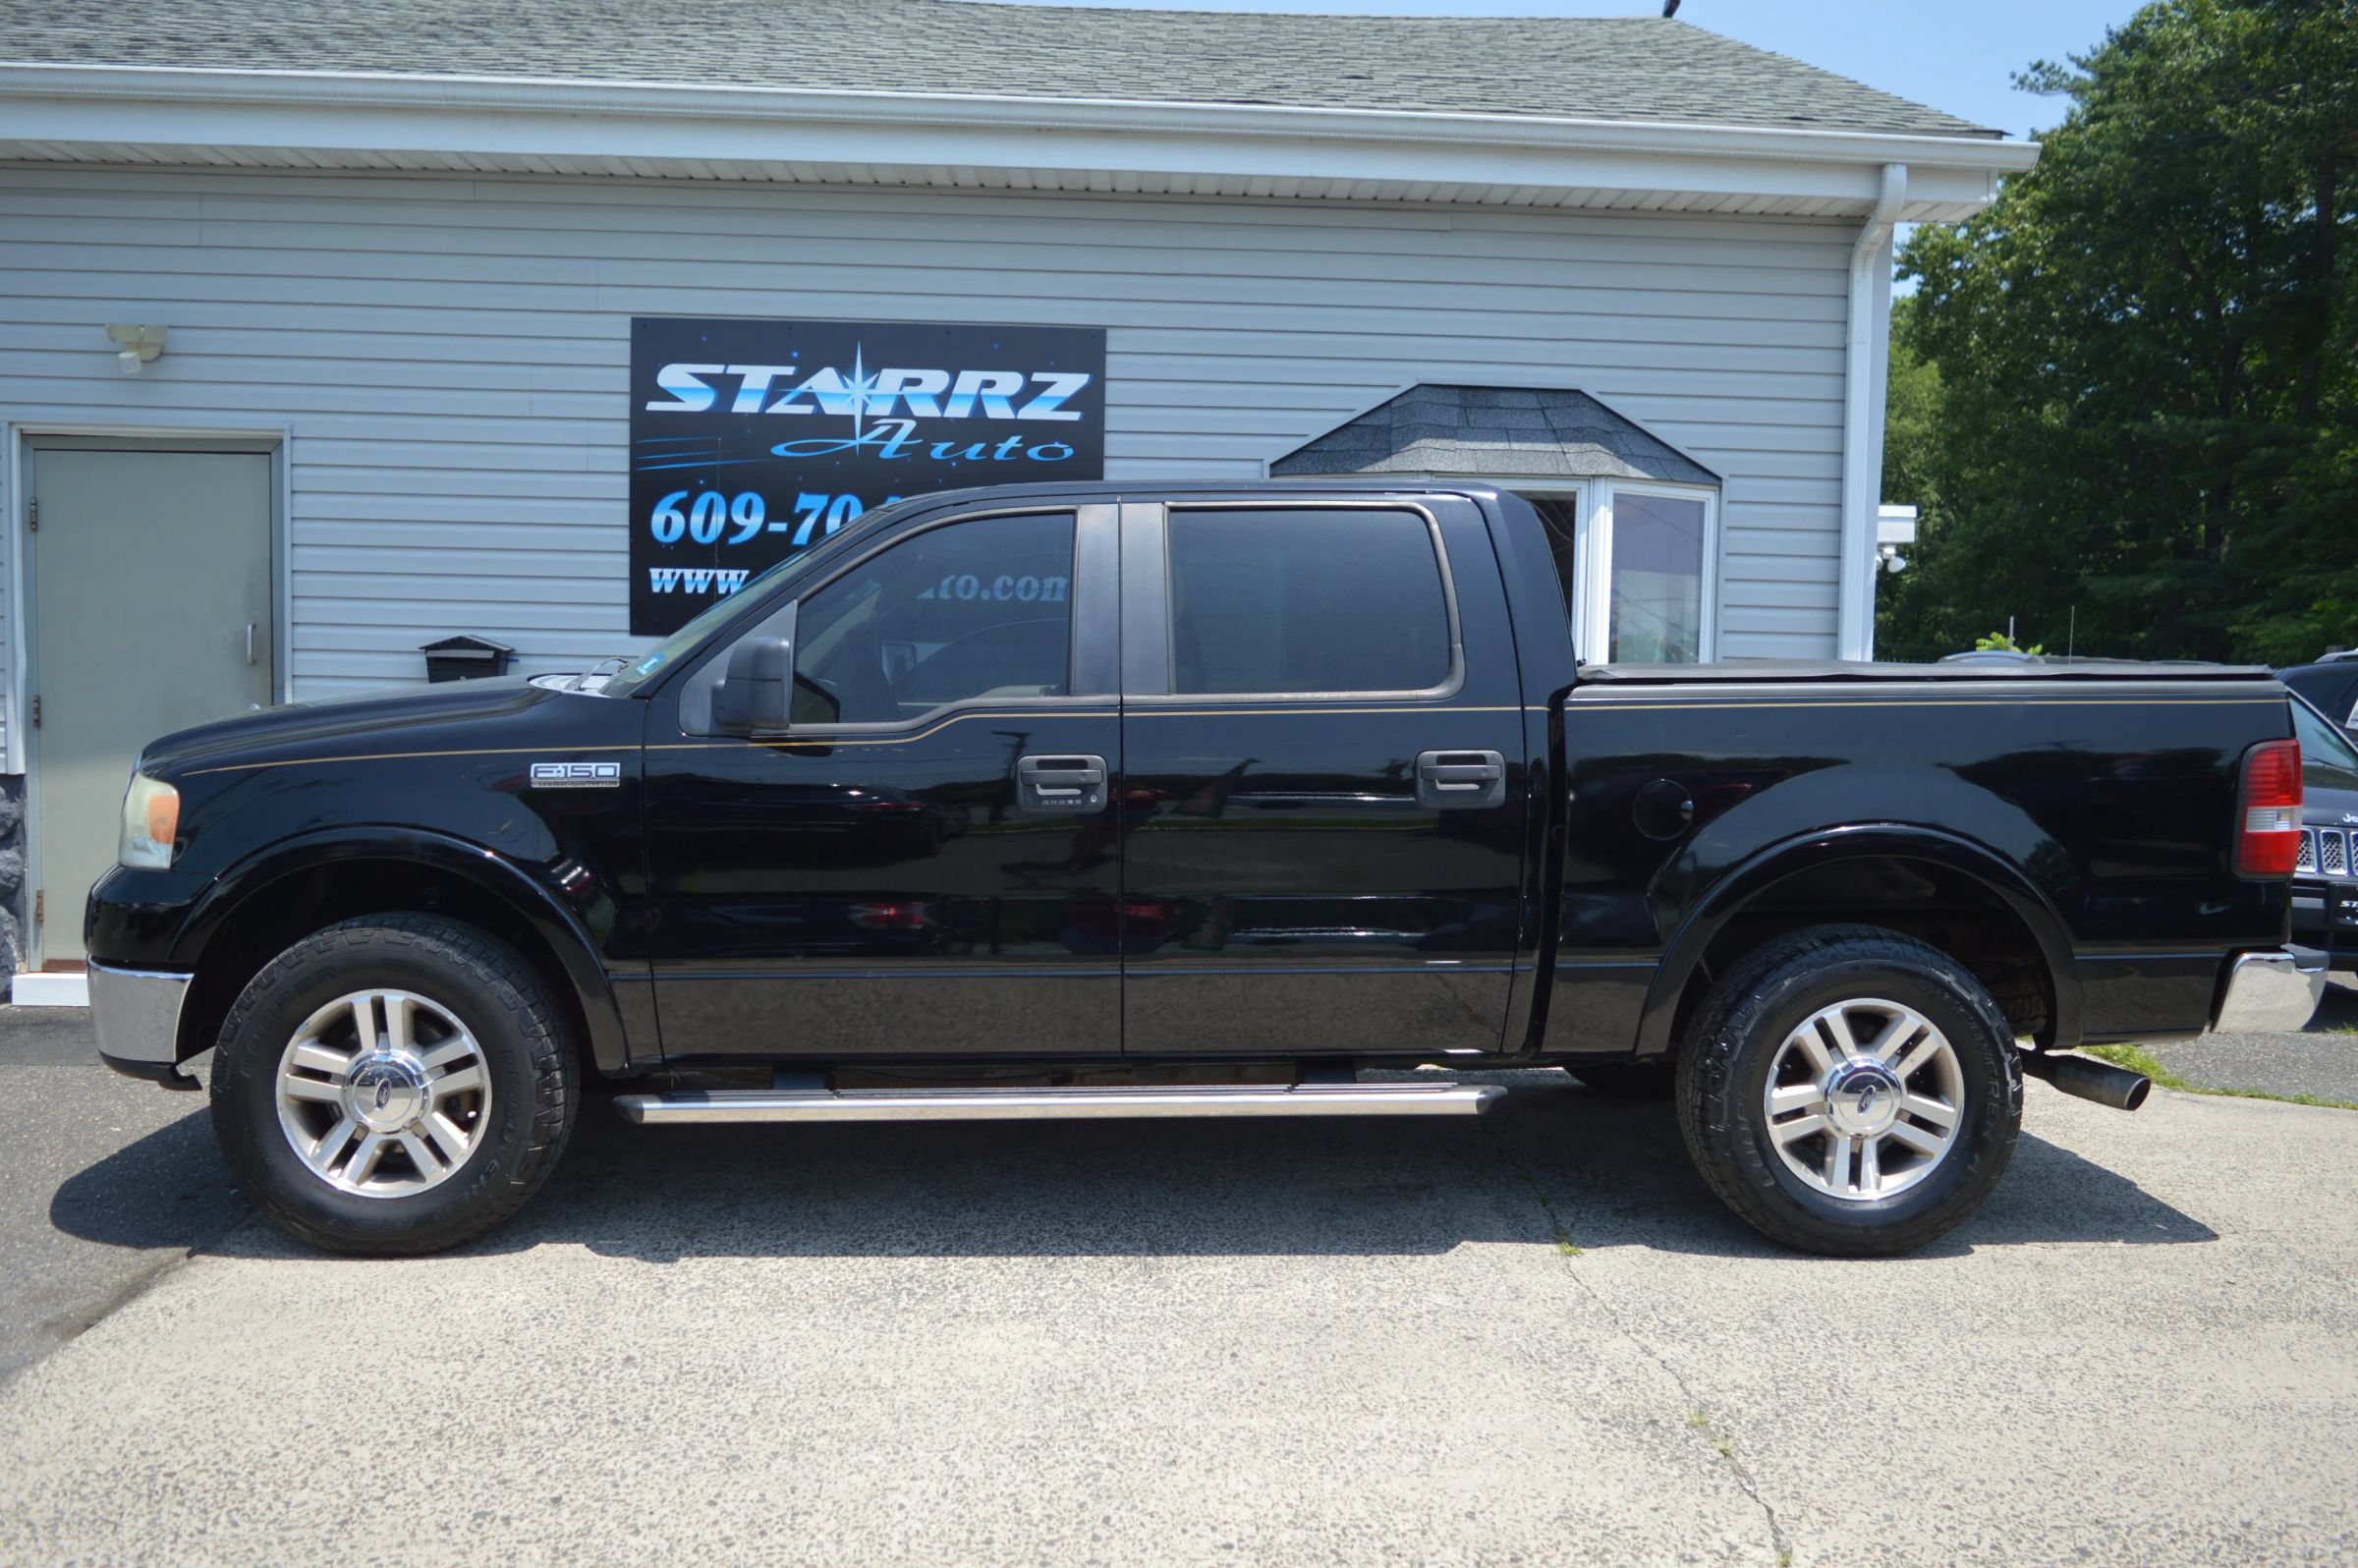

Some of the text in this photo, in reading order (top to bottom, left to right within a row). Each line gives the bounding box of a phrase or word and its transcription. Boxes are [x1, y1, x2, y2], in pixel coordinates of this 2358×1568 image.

[646, 363, 1091, 420] STARRZ
[770, 419, 1075, 461] Auto
[649, 490, 901, 545] 609-70
